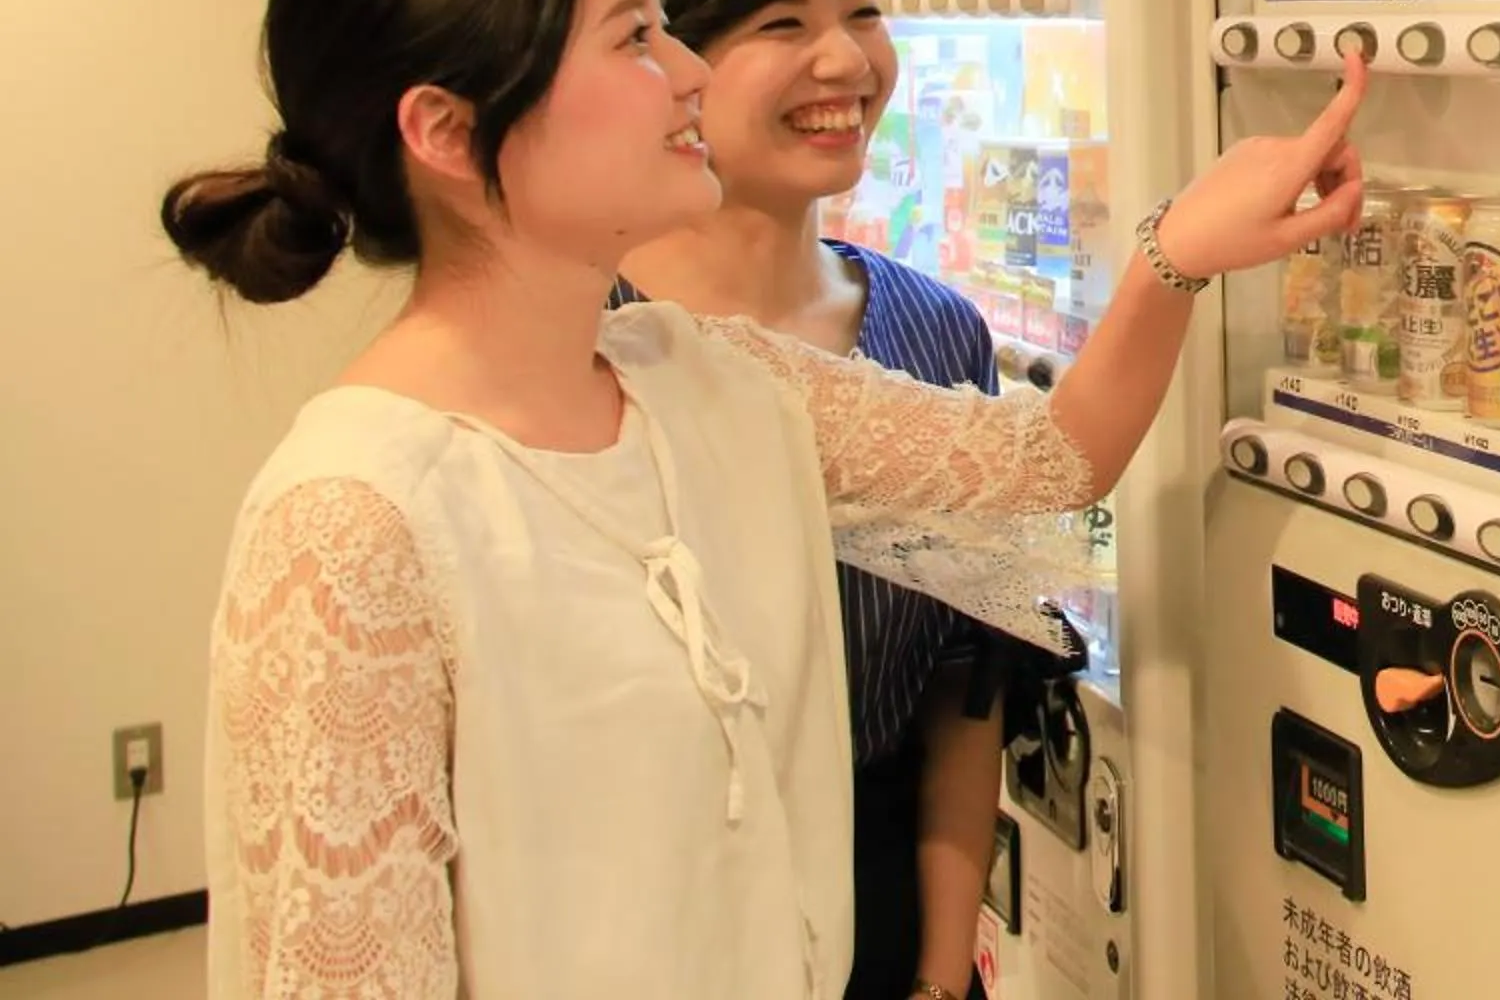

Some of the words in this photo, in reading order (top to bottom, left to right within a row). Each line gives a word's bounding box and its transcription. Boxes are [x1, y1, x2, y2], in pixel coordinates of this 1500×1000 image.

[1283, 895, 1411, 1000] 未成年者の飲酒
[1283, 936, 1384, 1000] および飲酒
